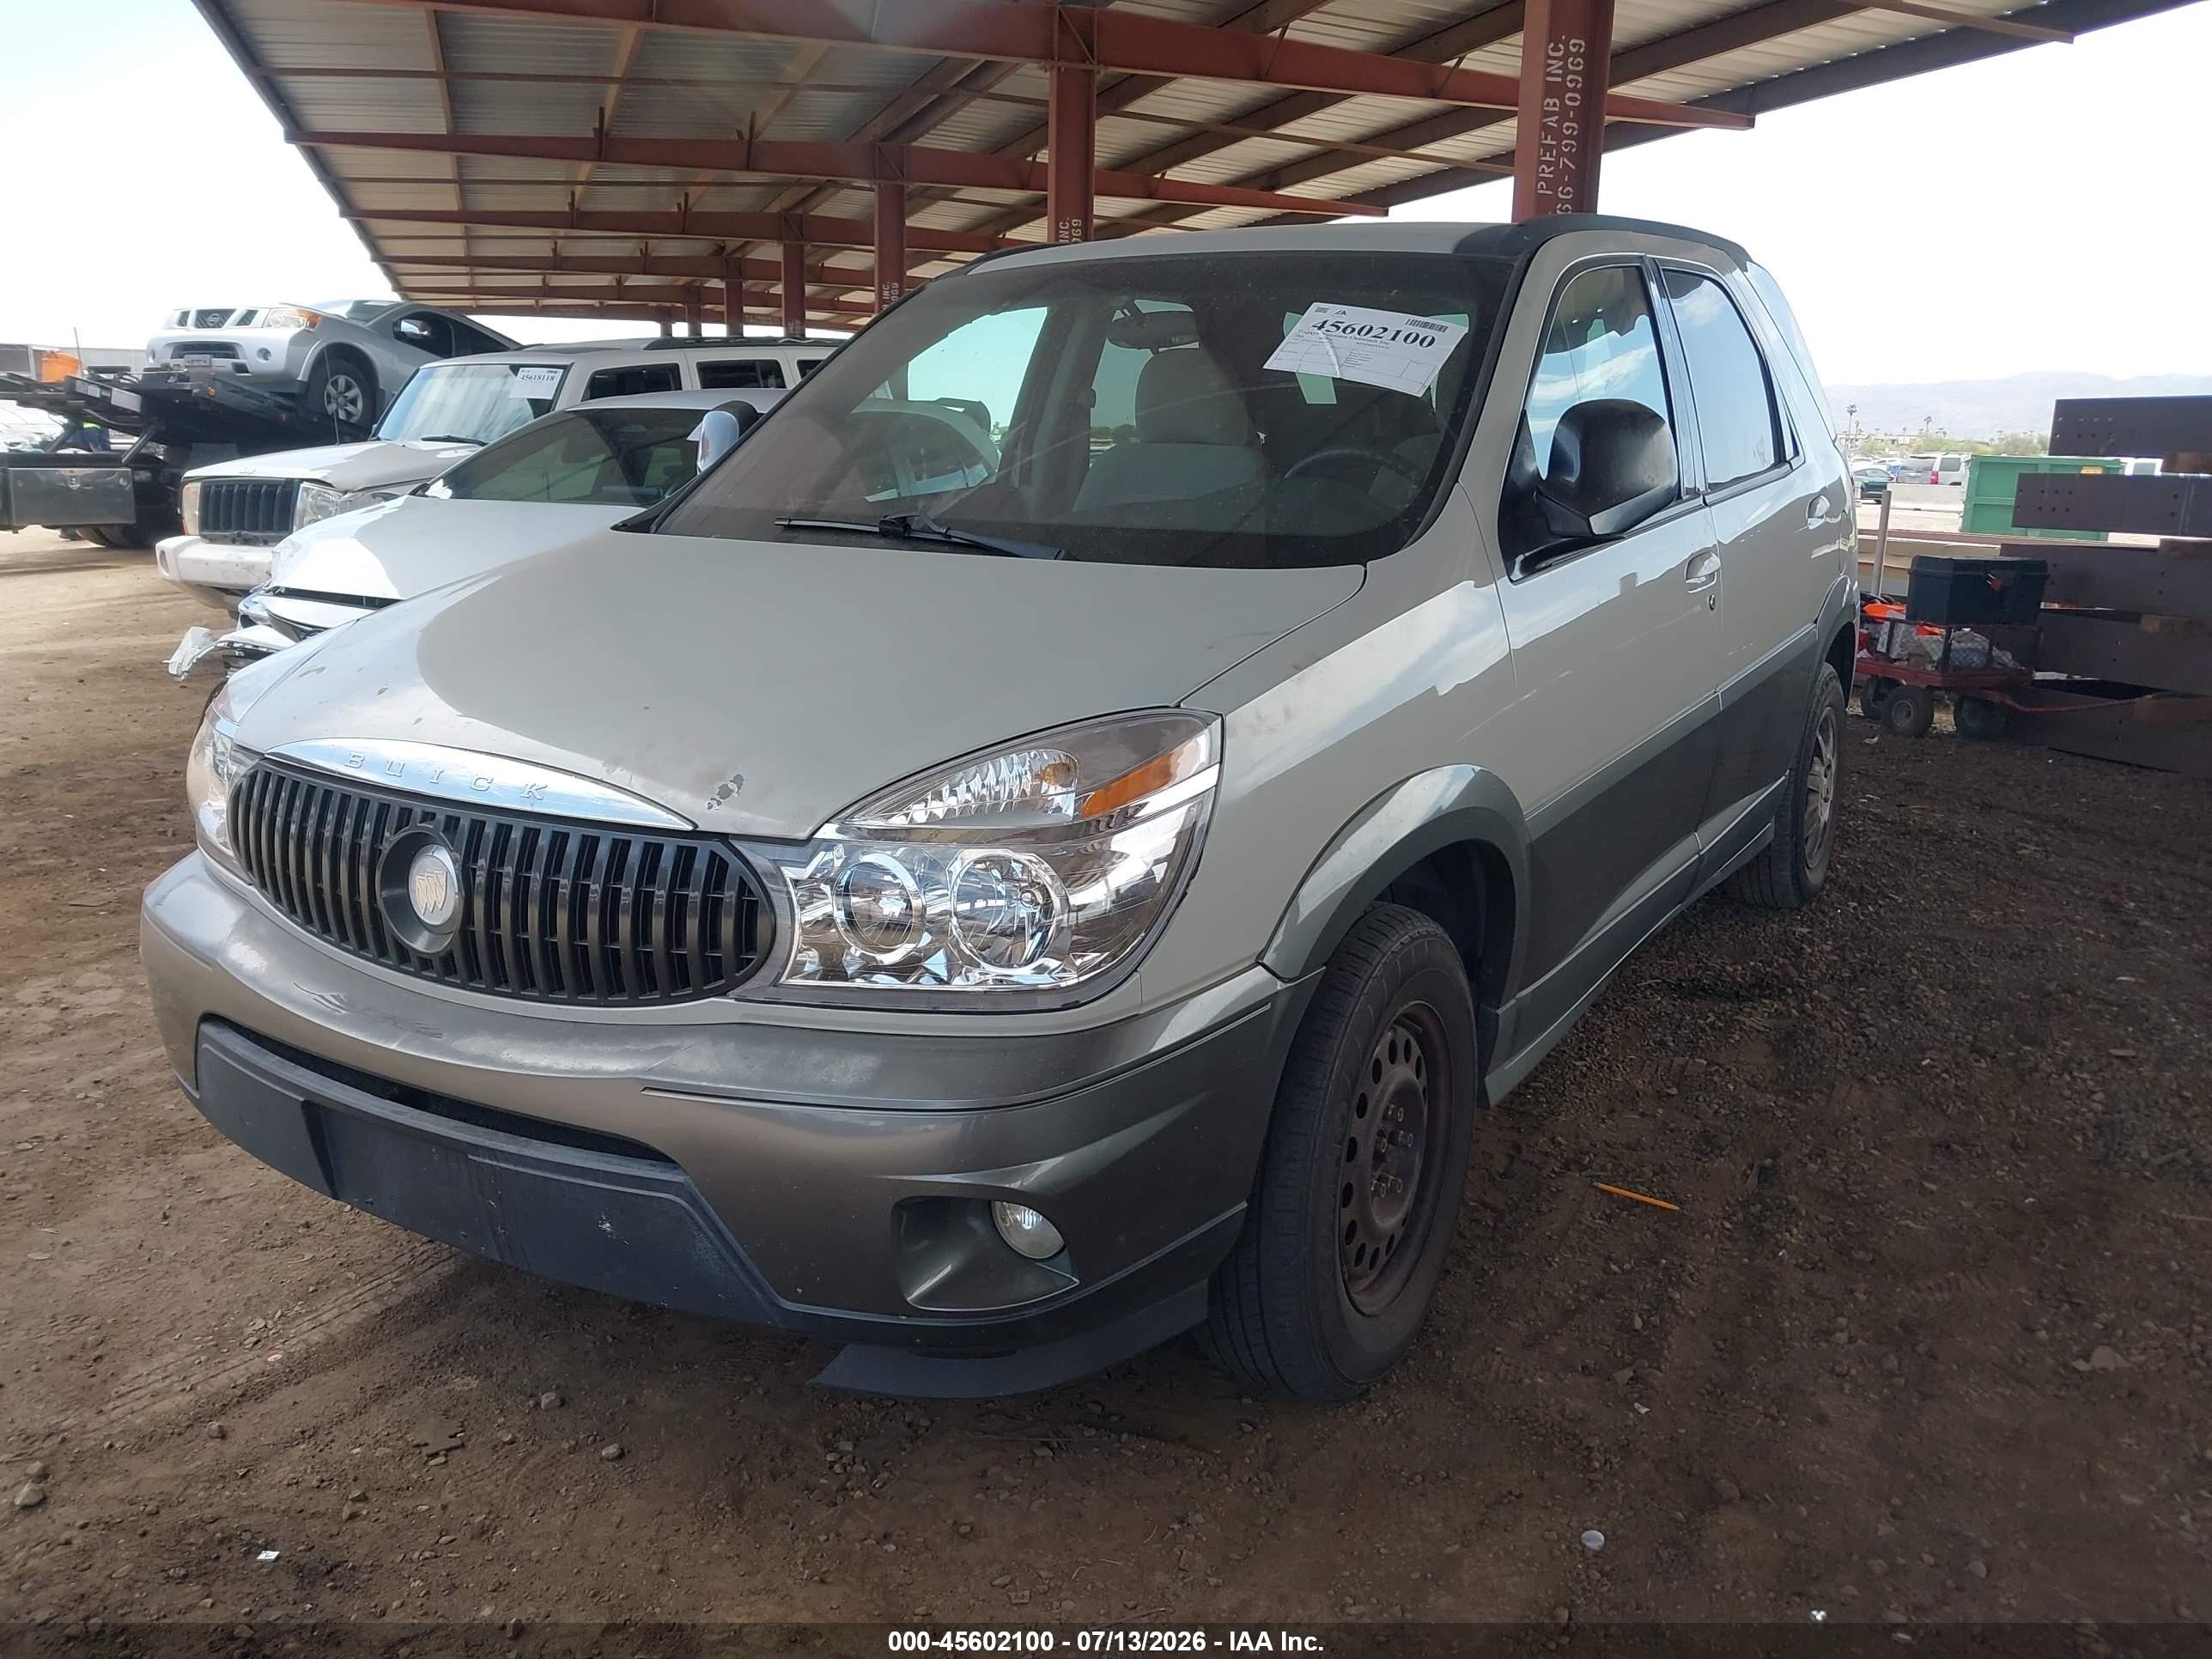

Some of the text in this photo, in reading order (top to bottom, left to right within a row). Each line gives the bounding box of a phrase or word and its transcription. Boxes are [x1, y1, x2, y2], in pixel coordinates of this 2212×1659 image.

[1537, 34, 1566, 195] PREFAB INC.
[1311, 319, 1437, 349] 45602100
[343, 751, 550, 800] BUICK
